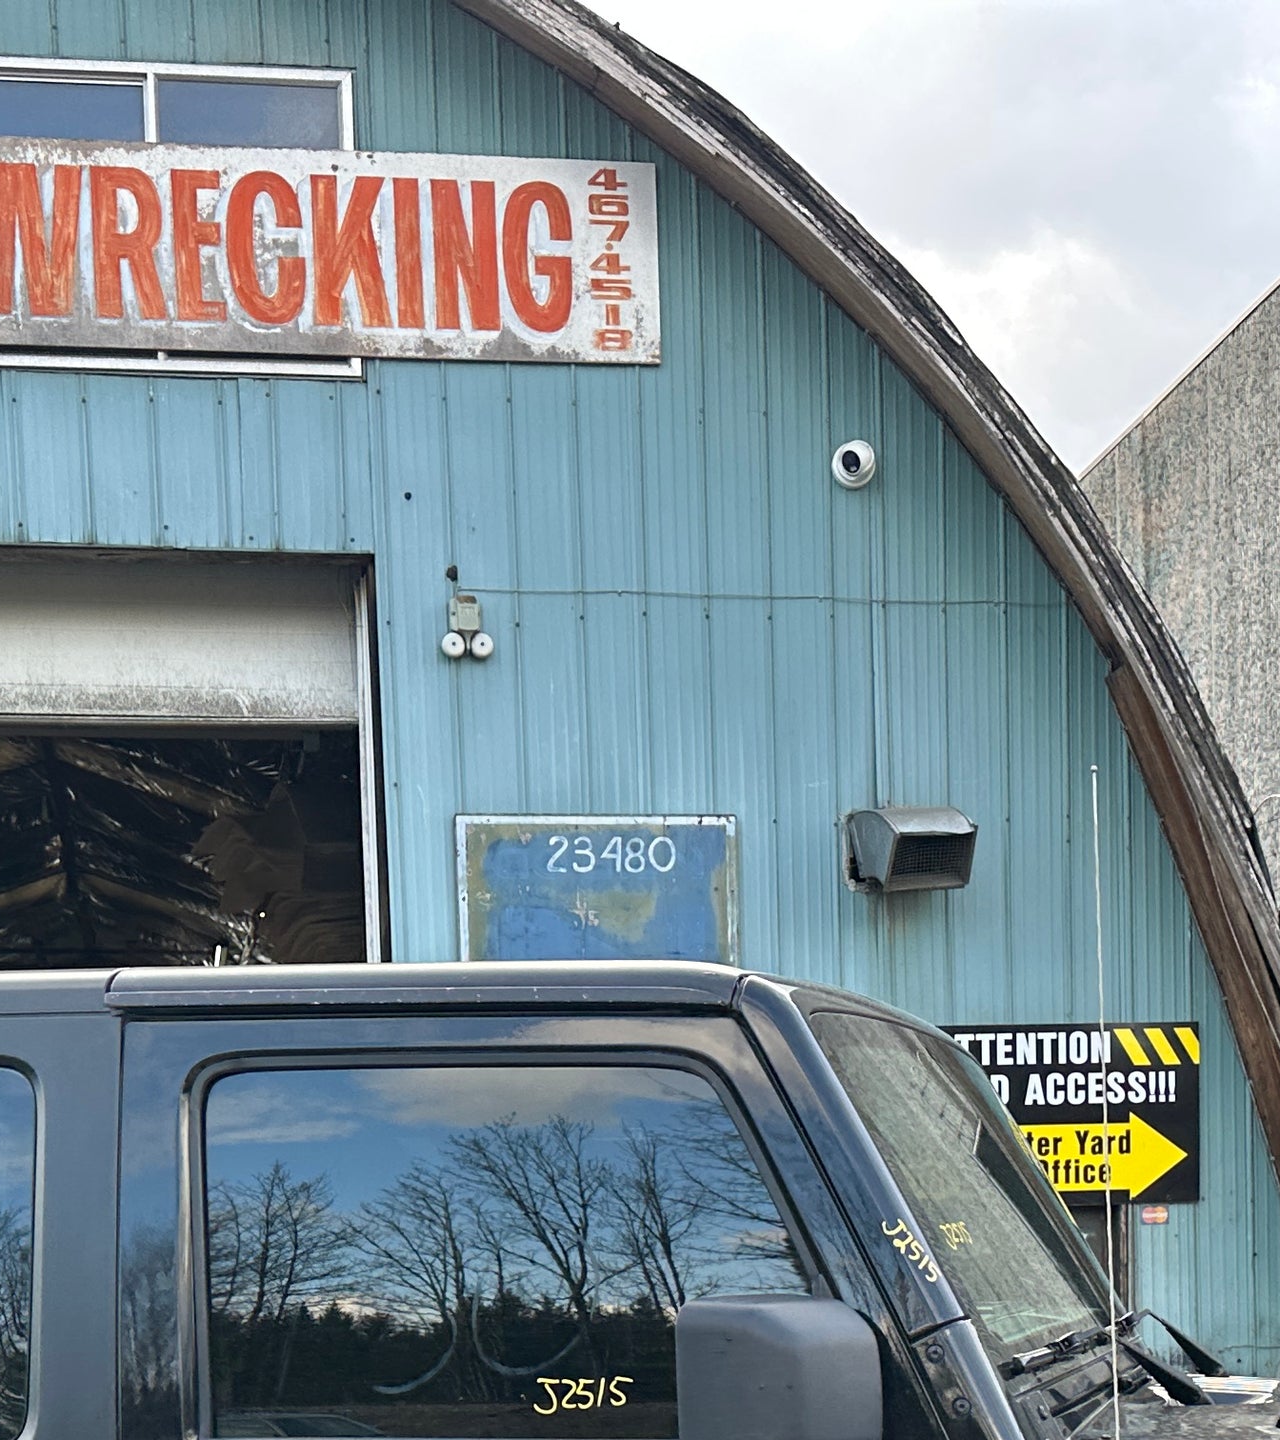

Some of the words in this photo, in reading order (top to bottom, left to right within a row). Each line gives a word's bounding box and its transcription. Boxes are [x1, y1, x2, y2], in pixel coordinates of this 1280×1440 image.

[546, 836, 677, 874] 23480
[953, 1031, 1111, 1066] TTENTION
[1024, 1070, 1176, 1106] ACCESS!!!
[1026, 1131, 1062, 1156] ter
[1075, 1129, 1131, 1155] Yard
[533, 1376, 634, 1415] J2515
